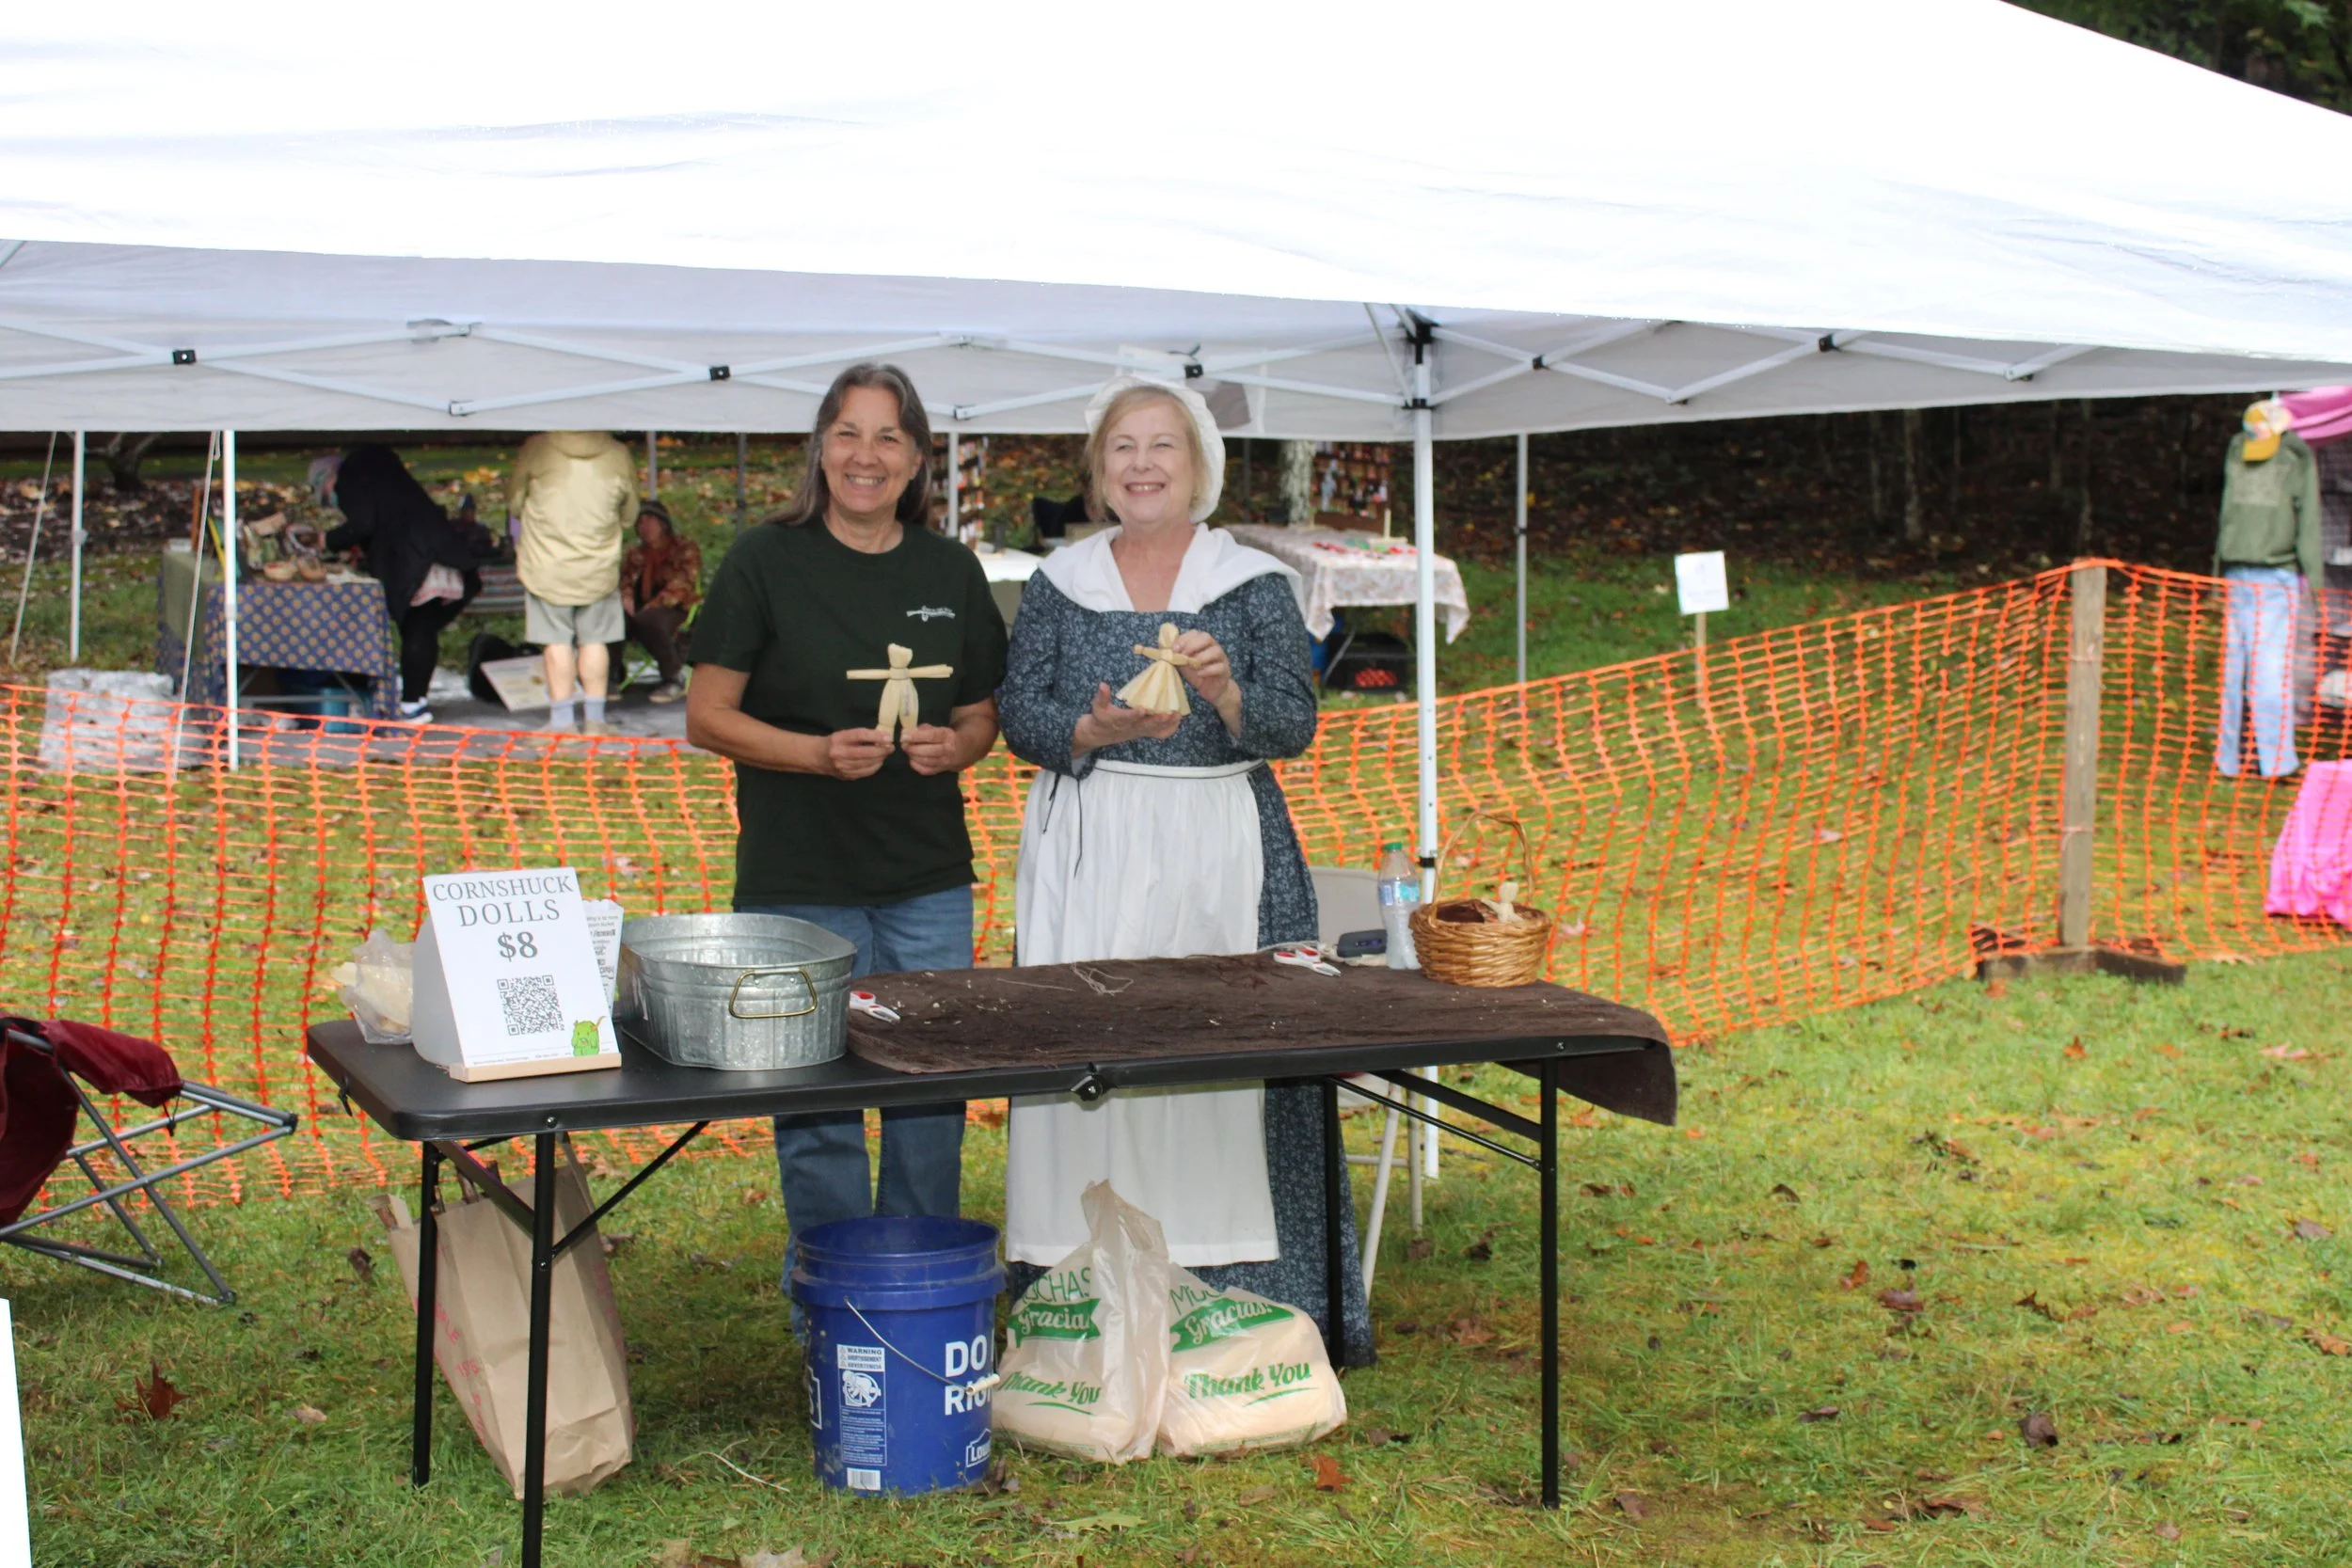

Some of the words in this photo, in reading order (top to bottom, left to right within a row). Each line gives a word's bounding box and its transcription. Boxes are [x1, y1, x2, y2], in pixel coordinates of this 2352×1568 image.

[433, 876, 574, 901] CORNSHUCK
[457, 898, 560, 927] DOLLS
[498, 931, 538, 962] $8
[946, 1334, 988, 1377] DO
[1068, 1382, 1101, 1405] You
[1184, 1368, 1264, 1400] Thank
[1267, 1362, 1312, 1386] You
